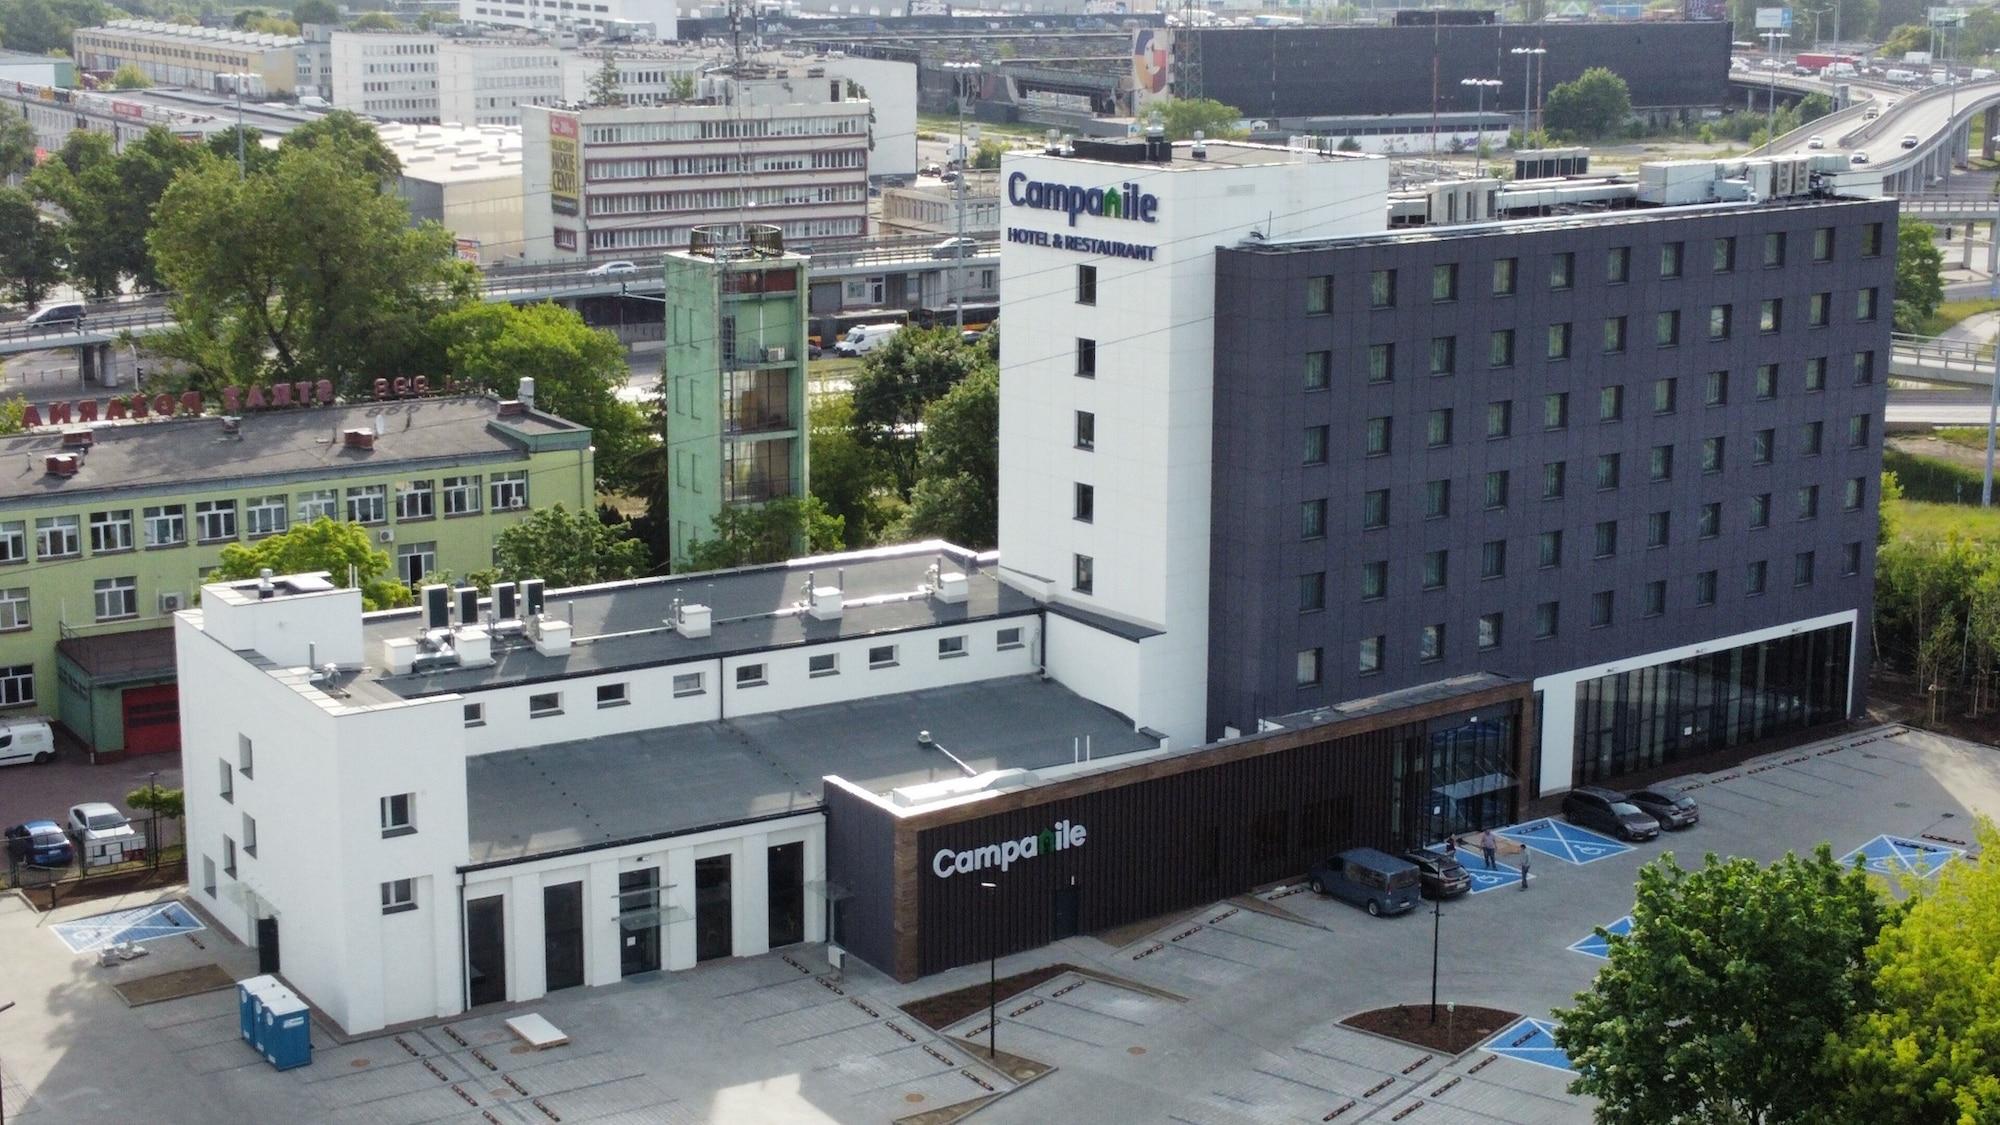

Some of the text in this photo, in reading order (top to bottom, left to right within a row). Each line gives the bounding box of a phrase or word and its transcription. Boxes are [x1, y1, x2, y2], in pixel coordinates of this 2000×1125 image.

[1008, 171, 1159, 227] Campanile
[1008, 227, 1157, 262] HOTEL & RESTAURANT
[932, 819, 1087, 879] Campanile
